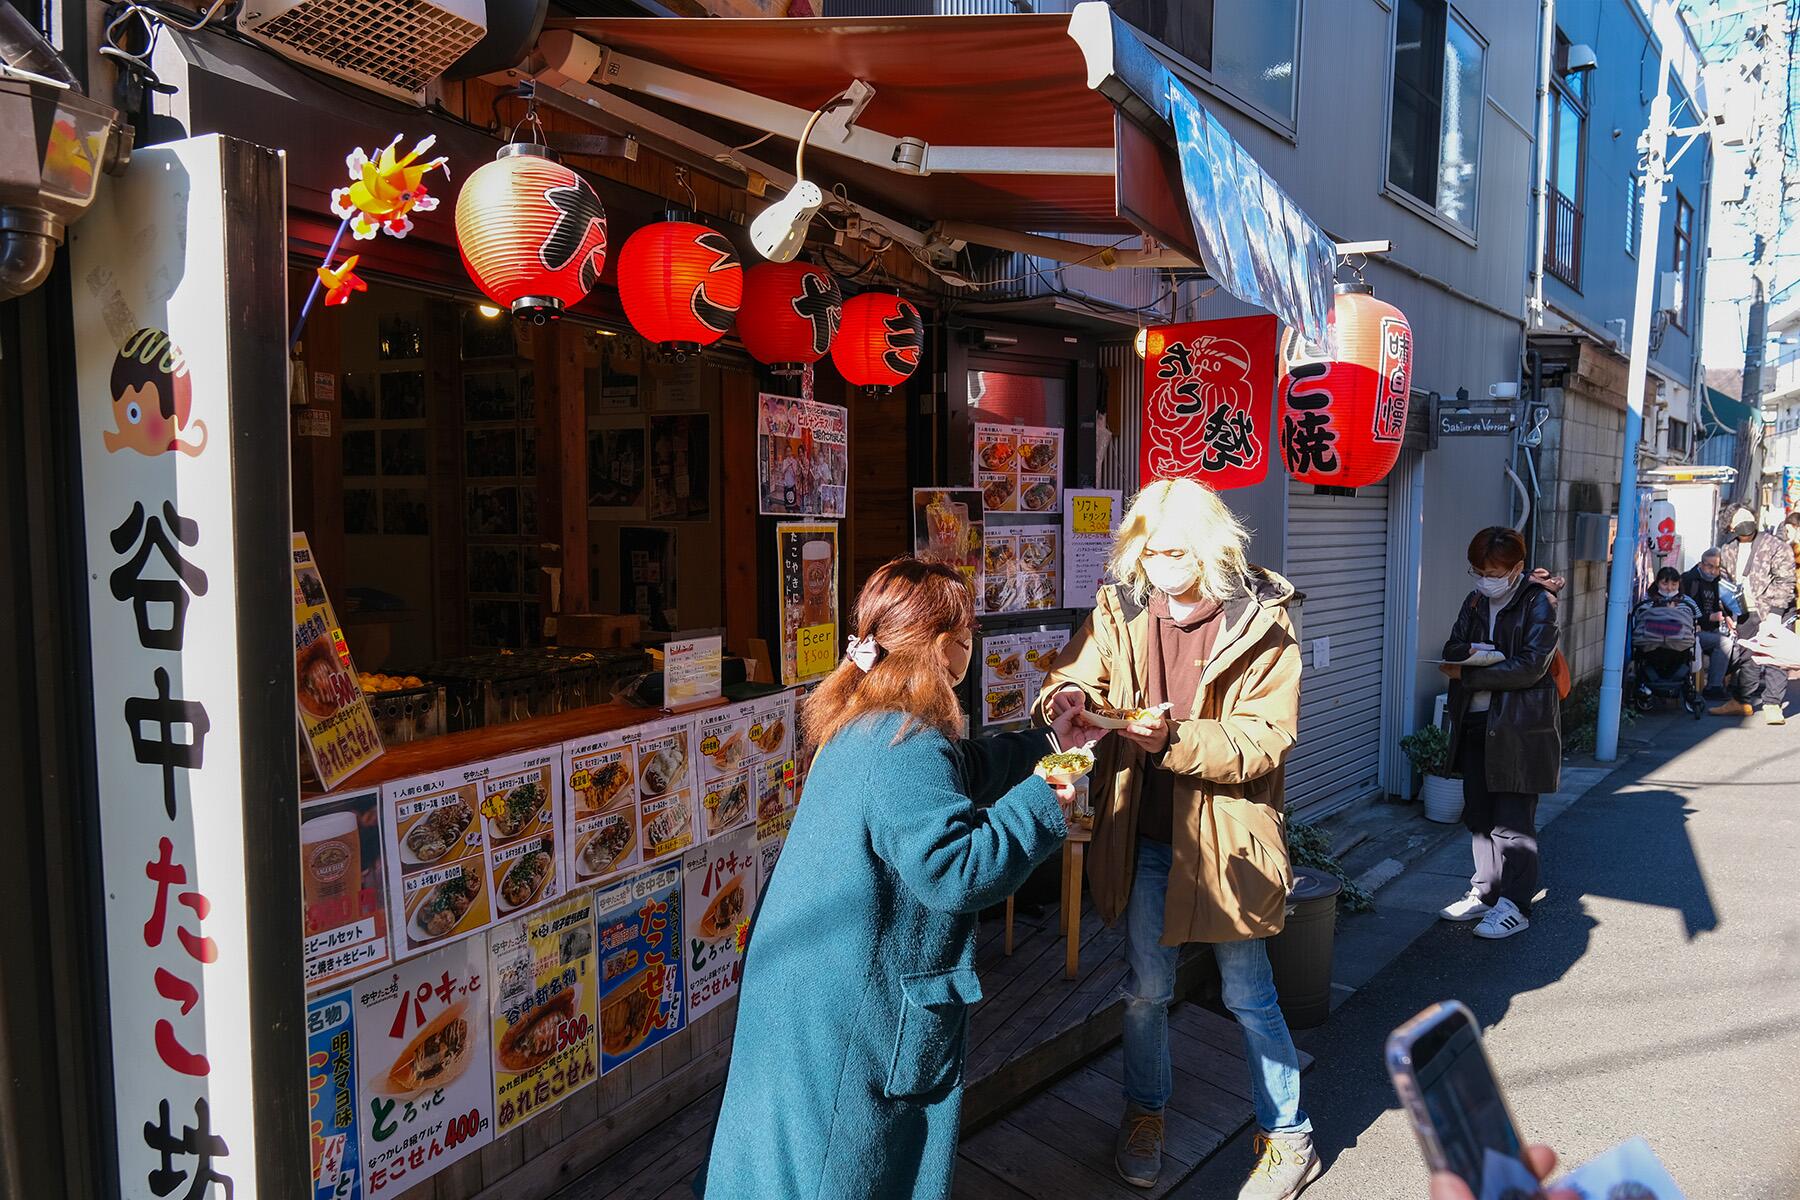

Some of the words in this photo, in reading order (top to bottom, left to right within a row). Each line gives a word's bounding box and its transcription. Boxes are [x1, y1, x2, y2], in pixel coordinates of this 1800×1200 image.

[802, 628, 831, 648] Beer
[317, 722, 379, 778] ぬれたこせん
[639, 897, 670, 1037] たこせん
[361, 983, 399, 1005] 谷中たこ坊
[690, 978, 731, 1010] たこせん
[308, 1005, 342, 1034] 名物
[556, 1013, 594, 1053] 500円
[332, 1031, 352, 1129] 明太マヨ味
[499, 1055, 595, 1127] ぬれたこせん
[368, 1138, 444, 1195] たこせん
[444, 1108, 489, 1150] 400円
